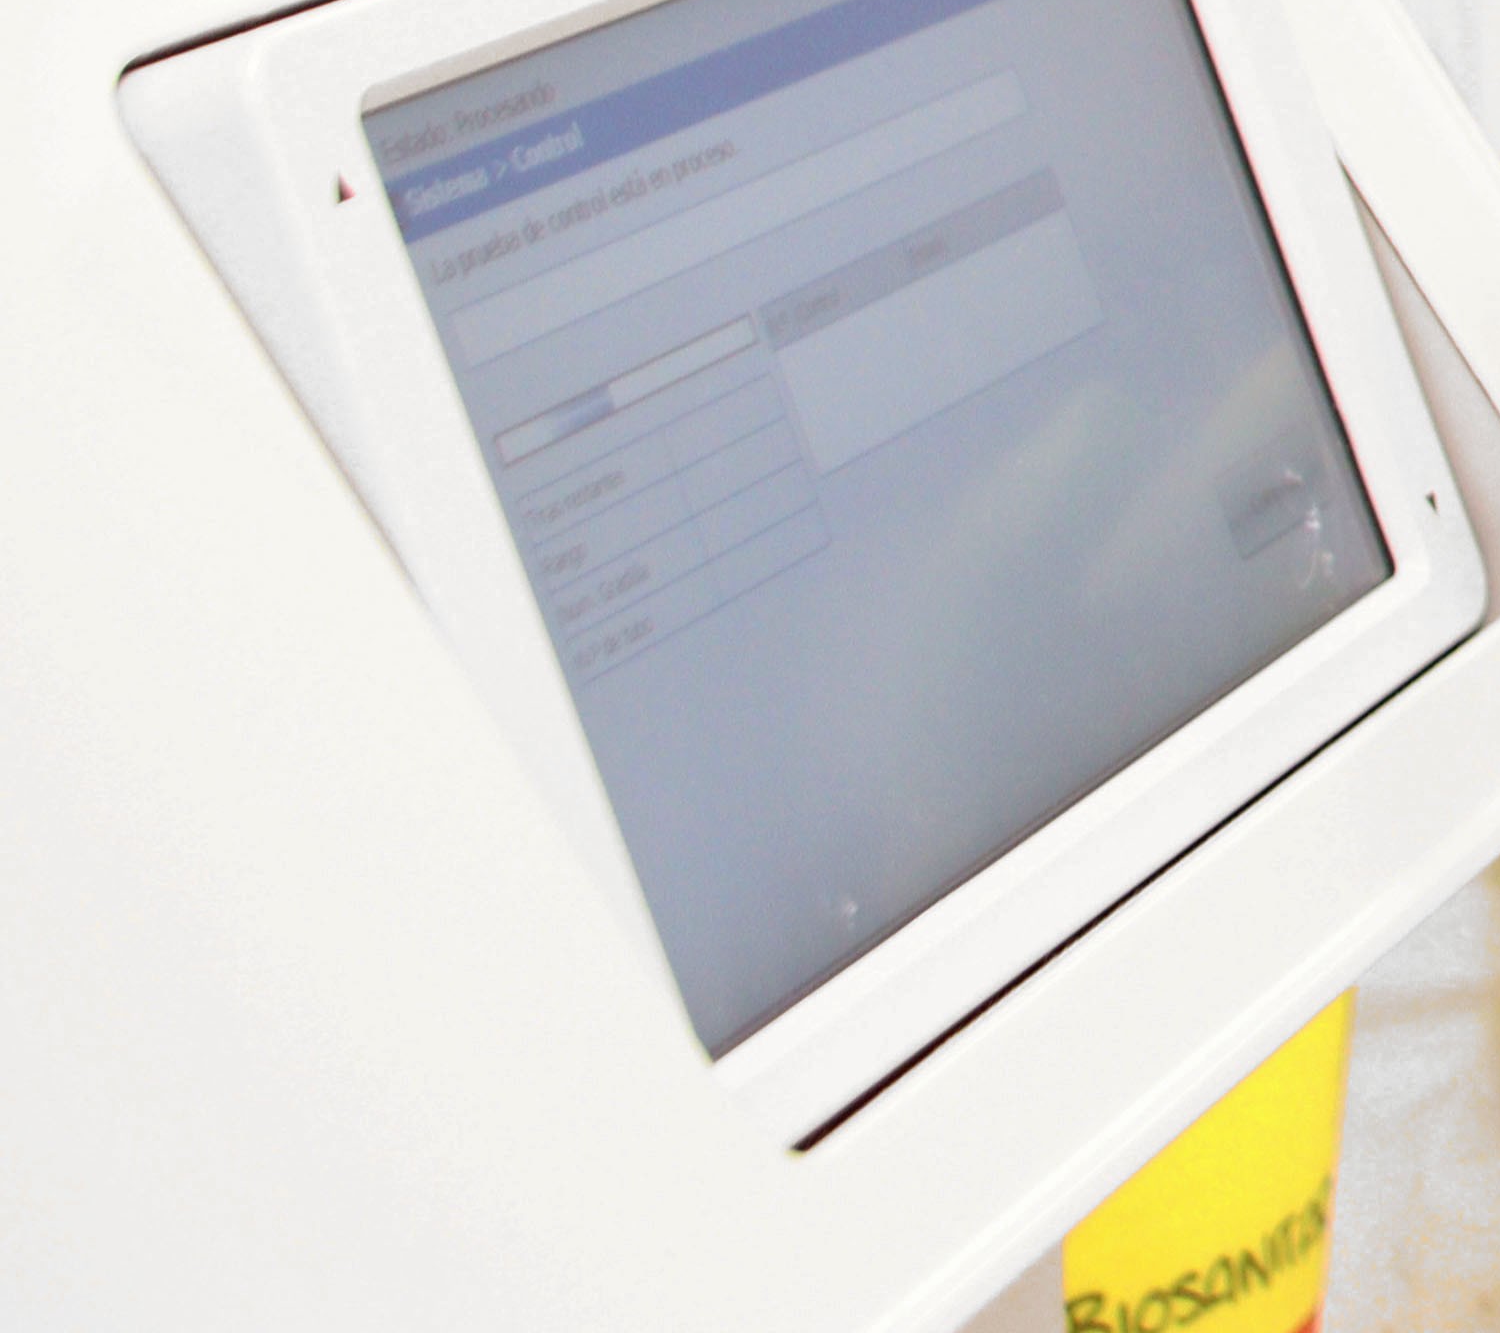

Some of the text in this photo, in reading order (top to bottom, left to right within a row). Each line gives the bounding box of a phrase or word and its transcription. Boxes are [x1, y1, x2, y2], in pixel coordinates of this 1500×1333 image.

[403, 166, 489, 216] Sistema
[509, 120, 587, 173] Control
[430, 260, 455, 287] La
[456, 226, 522, 280] prueba
[522, 215, 545, 244] de
[548, 193, 609, 234] control
[610, 167, 649, 209] está
[649, 169, 674, 191] en
